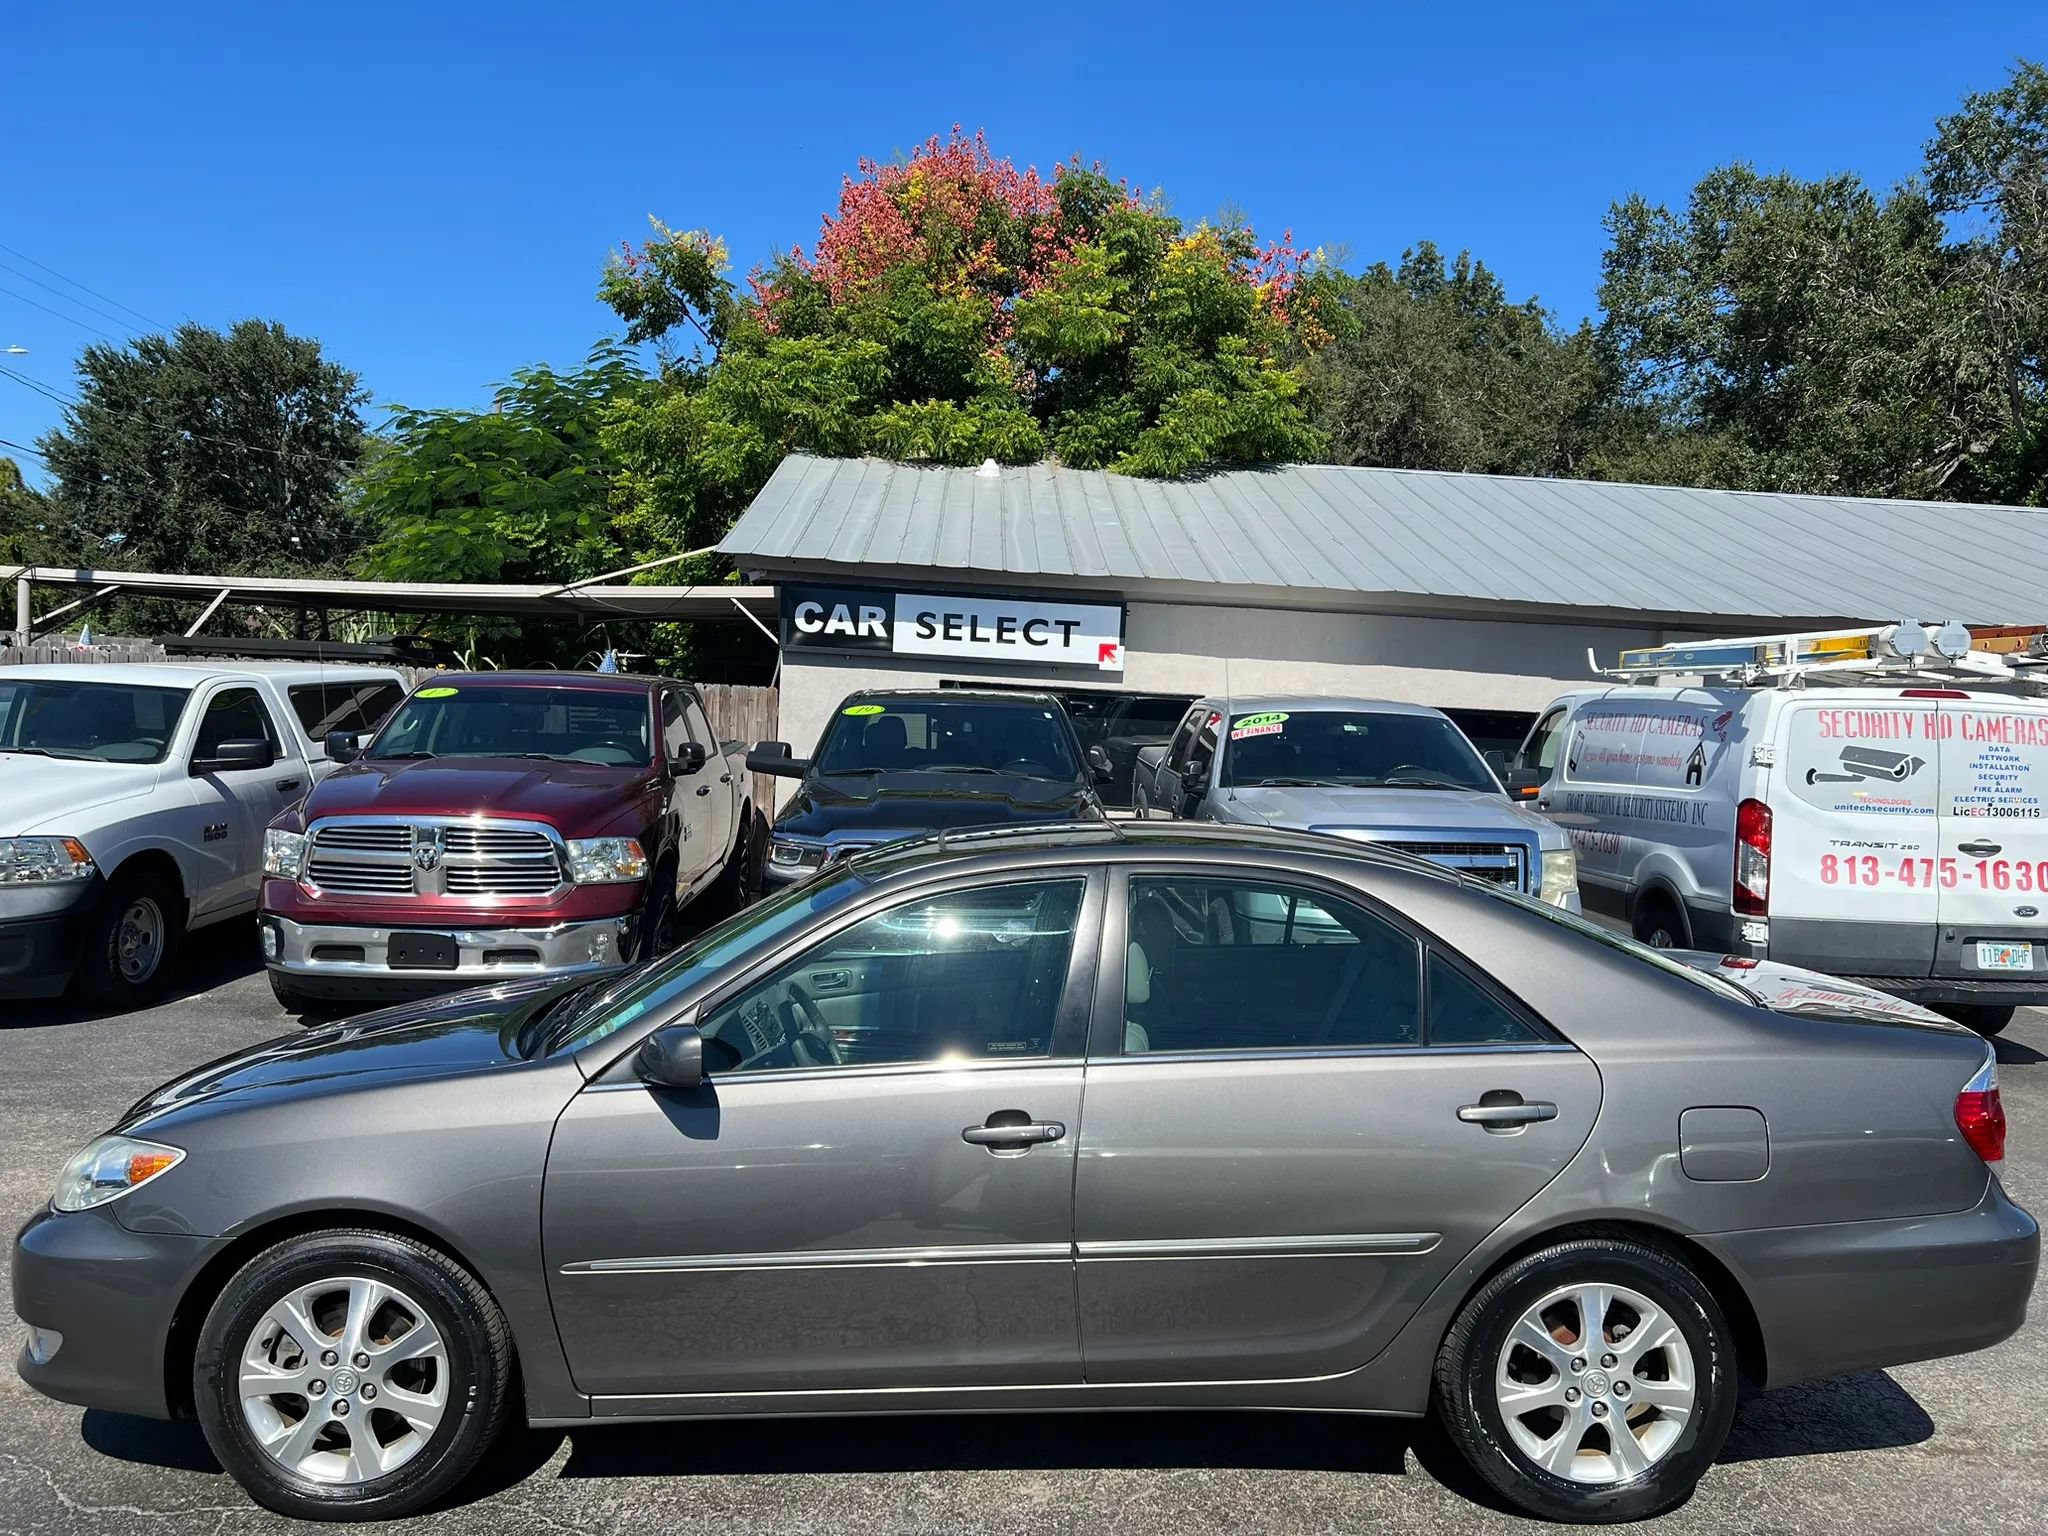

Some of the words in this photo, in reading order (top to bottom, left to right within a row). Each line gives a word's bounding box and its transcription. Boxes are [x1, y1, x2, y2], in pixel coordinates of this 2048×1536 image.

[794, 601, 888, 638] CAR
[915, 611, 1081, 648] SELECT
[1242, 714, 1281, 727] 2014
[1584, 712, 1631, 732] SECURITY
[1630, 713, 1648, 734] HD
[1648, 714, 1709, 738] CAMERAS
[1232, 730, 1245, 739] WE
[1246, 724, 1282, 735] FINANCE
[1818, 710, 1913, 739] SECURITY
[1923, 713, 1953, 740] HD
[1961, 714, 2048, 747] CAMERAS
[1988, 745, 2011, 753] DATA
[1978, 754, 2021, 763] NETWORK
[1969, 763, 2031, 772] INSTALLATION
[1978, 773, 2019, 781] SECURITY
[1994, 786, 2023, 794] ALARM
[1859, 796, 1912, 806] TECHNOLOGIES
[1954, 796, 1996, 804] ELECTRIC
[1584, 794, 1616, 816] SOLUTIONS
[1622, 797, 1654, 820] SECURITY
[1653, 800, 1689, 823] SYSTEMS
[1691, 802, 1709, 826] INC
[1834, 803, 1935, 815] unitechsecurity.com
[1829, 840, 1899, 849] TRANSIT
[1820, 854, 2048, 893] 813-475-1630
